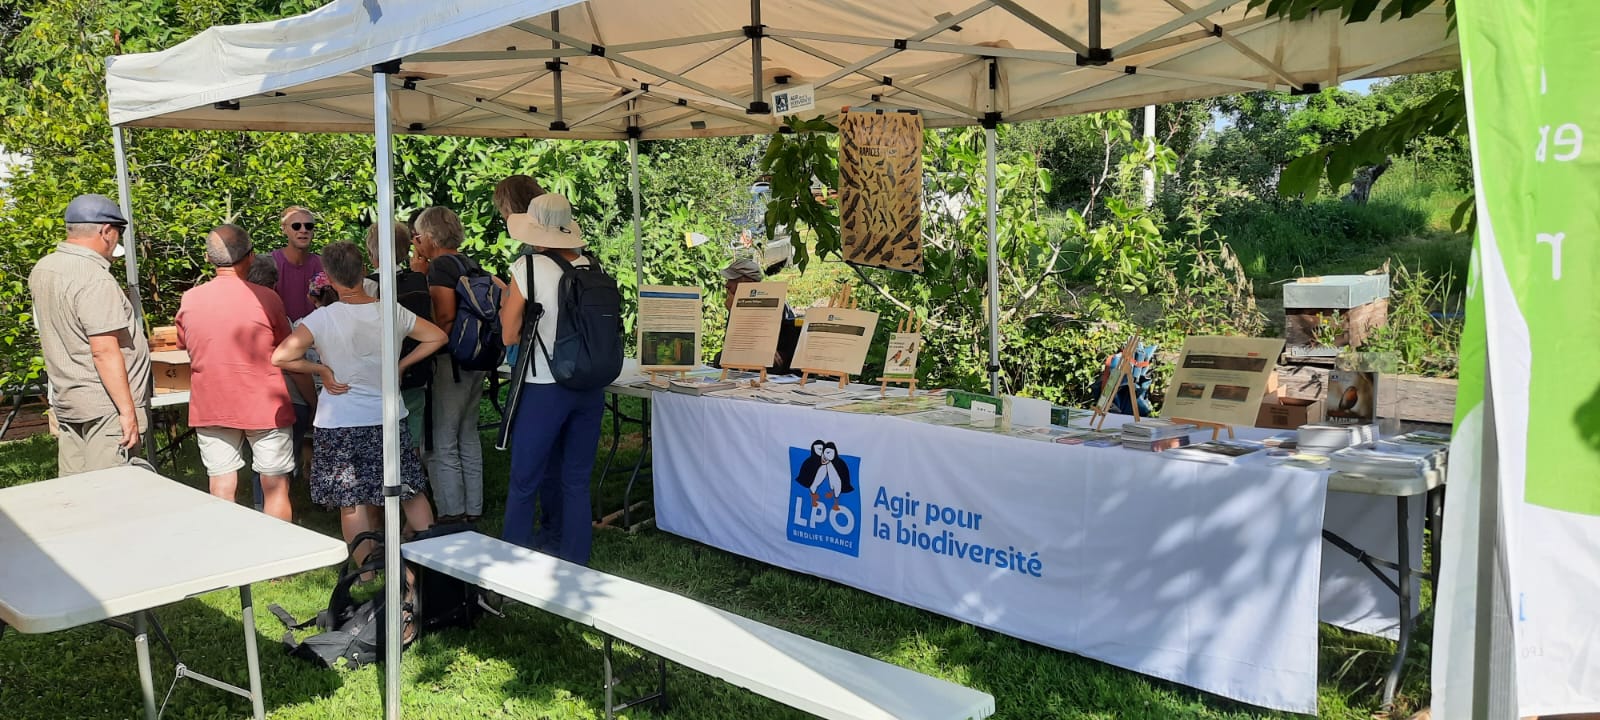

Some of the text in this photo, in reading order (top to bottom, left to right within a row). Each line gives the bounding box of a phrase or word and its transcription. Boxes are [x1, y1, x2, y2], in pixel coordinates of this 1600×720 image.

[793, 496, 855, 535] LPO
[873, 486, 982, 531] Agir pour
[792, 529, 853, 548] BIRDLIFE FRANCE
[873, 514, 1043, 578] la biodiversité
